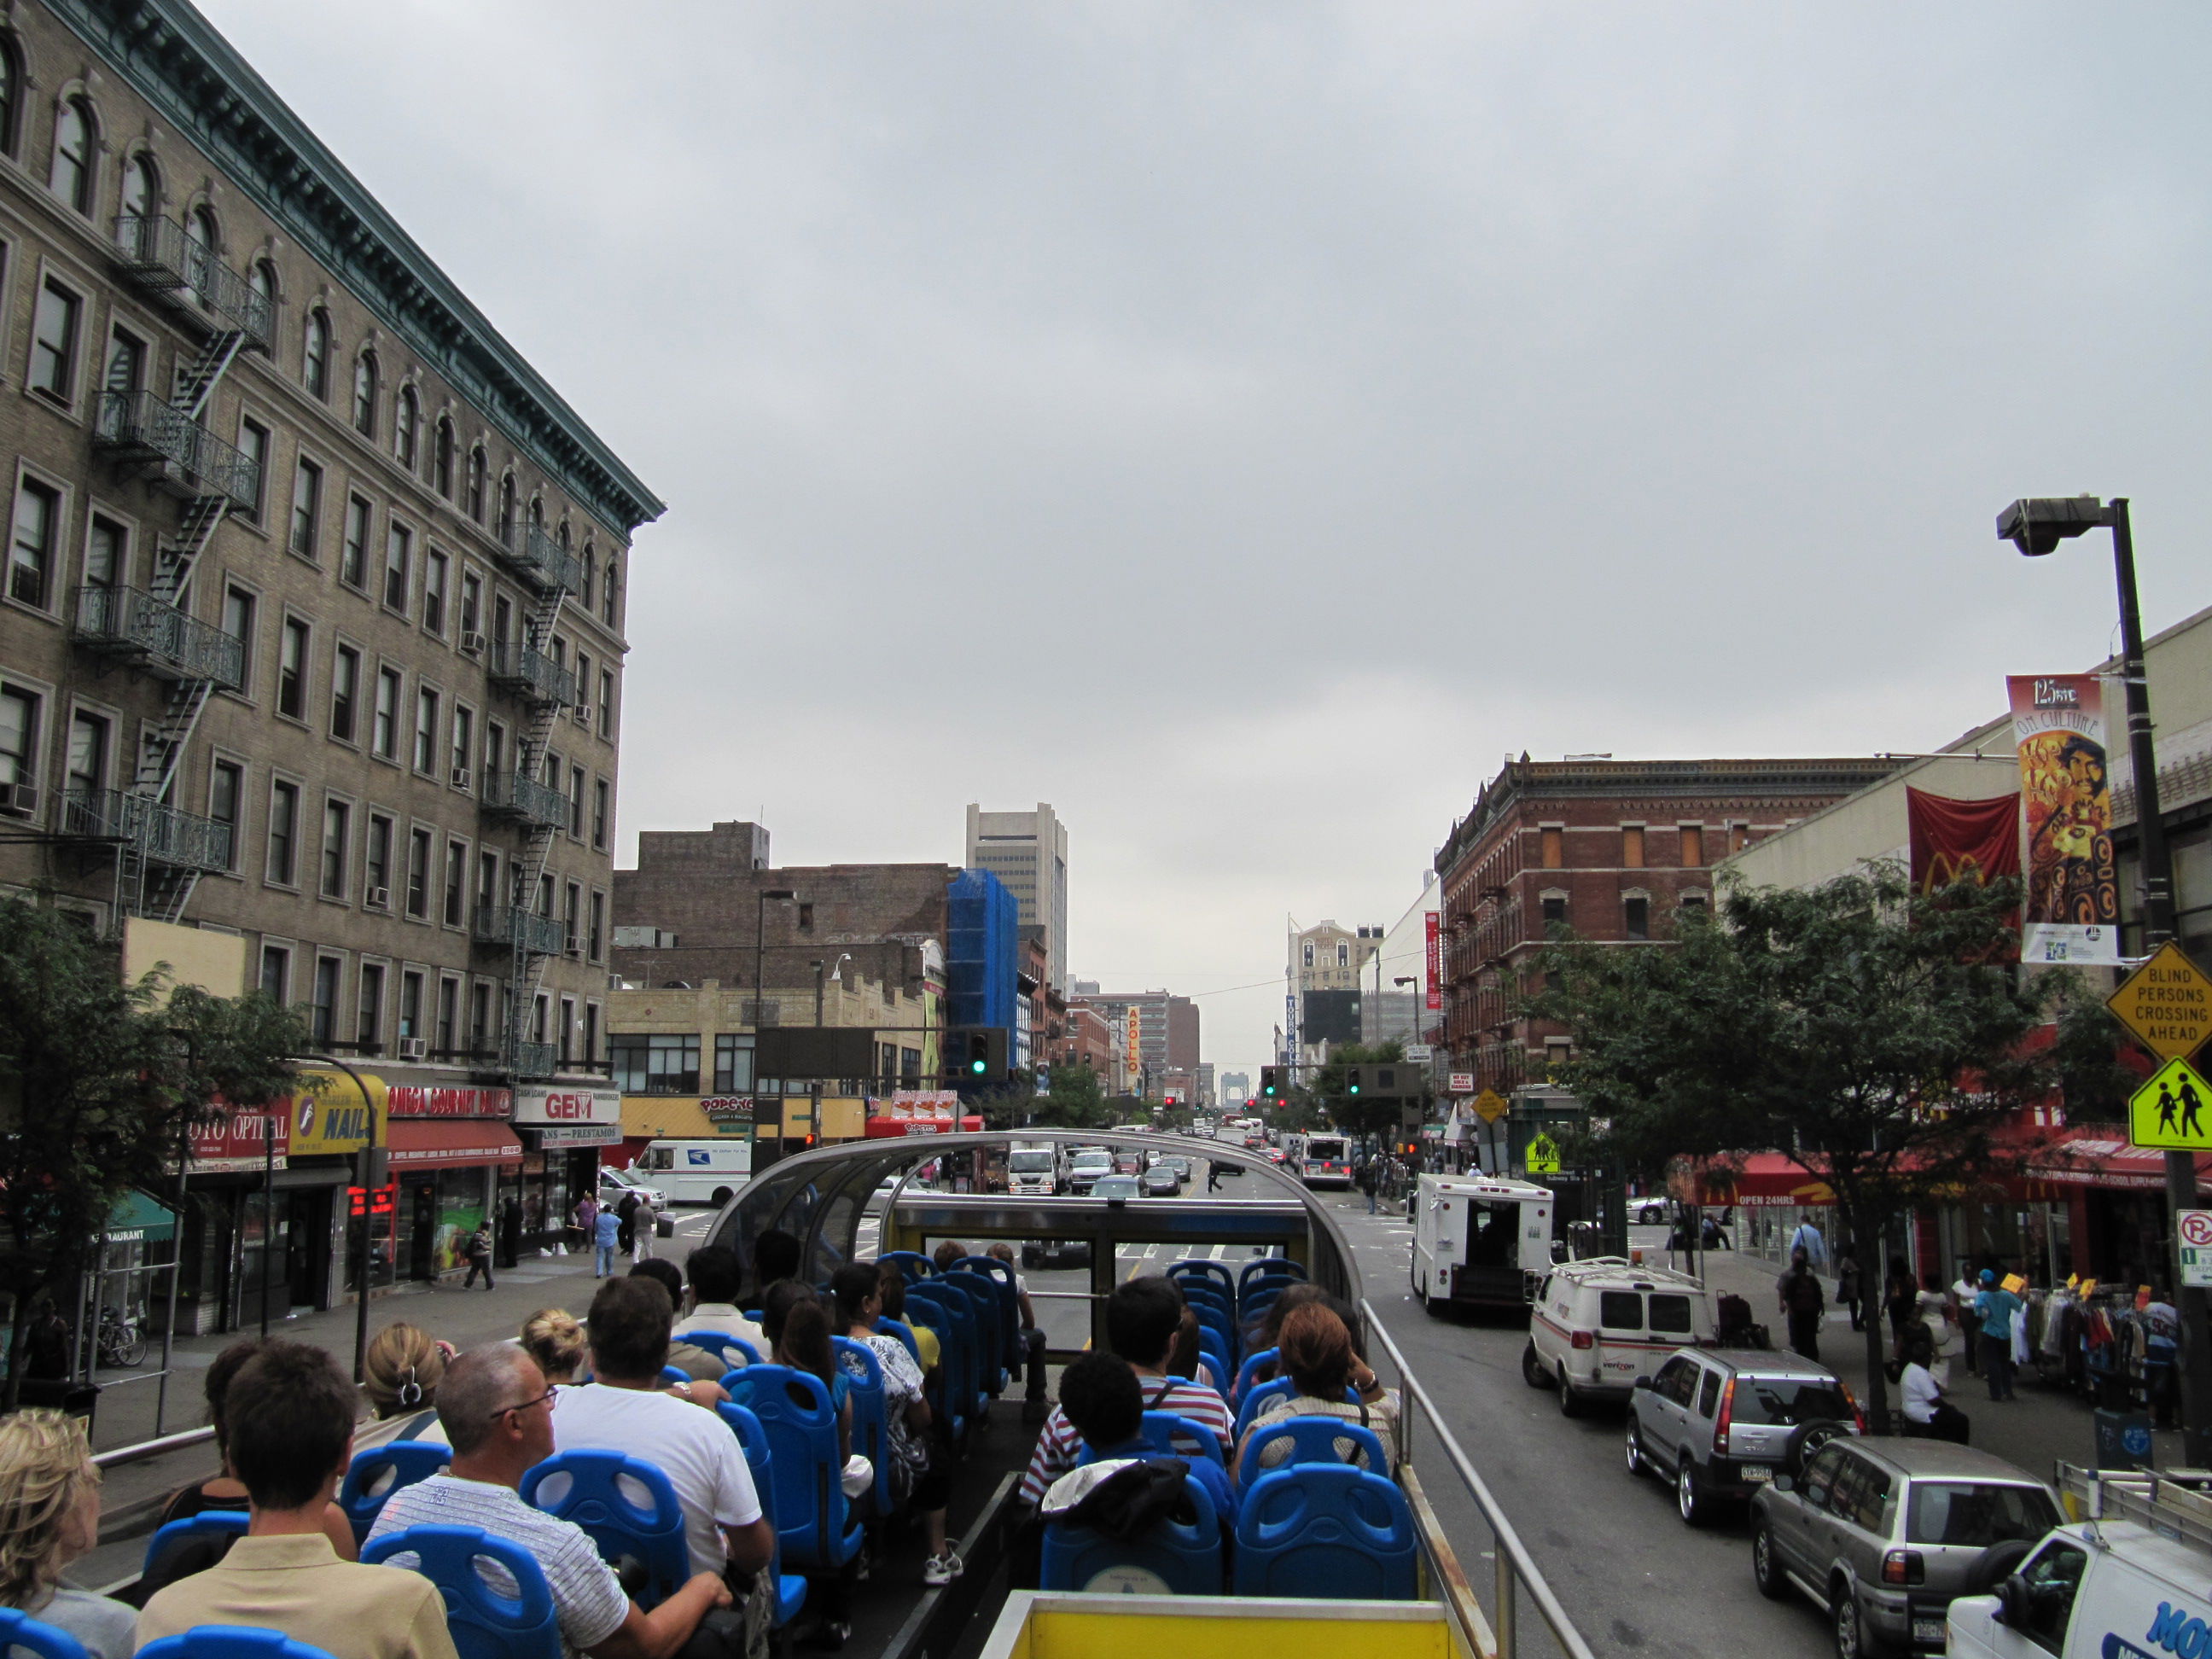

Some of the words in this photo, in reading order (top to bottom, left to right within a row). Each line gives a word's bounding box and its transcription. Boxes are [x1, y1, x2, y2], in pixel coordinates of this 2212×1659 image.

[2034, 679, 2055, 704] 125
[2040, 712, 2098, 736] CULTURE
[2149, 968, 2192, 983] BLIND
[2138, 987, 2204, 1003] PERSONS
[2135, 1006, 2208, 1022] CROSSING
[1129, 1010, 1138, 1072] APOLLO
[2148, 1027, 2197, 1040] AHEAD
[388, 1086, 426, 1114] OMEGA
[431, 1087, 476, 1115] GOURMET
[546, 1091, 592, 1120] GEM
[701, 1097, 753, 1113] POPEYE
[233, 1115, 288, 1140] OPTIAL
[573, 1128, 616, 1138] PRESTAMOS
[1739, 1196, 1763, 1205] OPEN
[1766, 1196, 1795, 1205] 24HRS
[1604, 1361, 1634, 1371] verizon
[2146, 1601, 2212, 1659] MO
